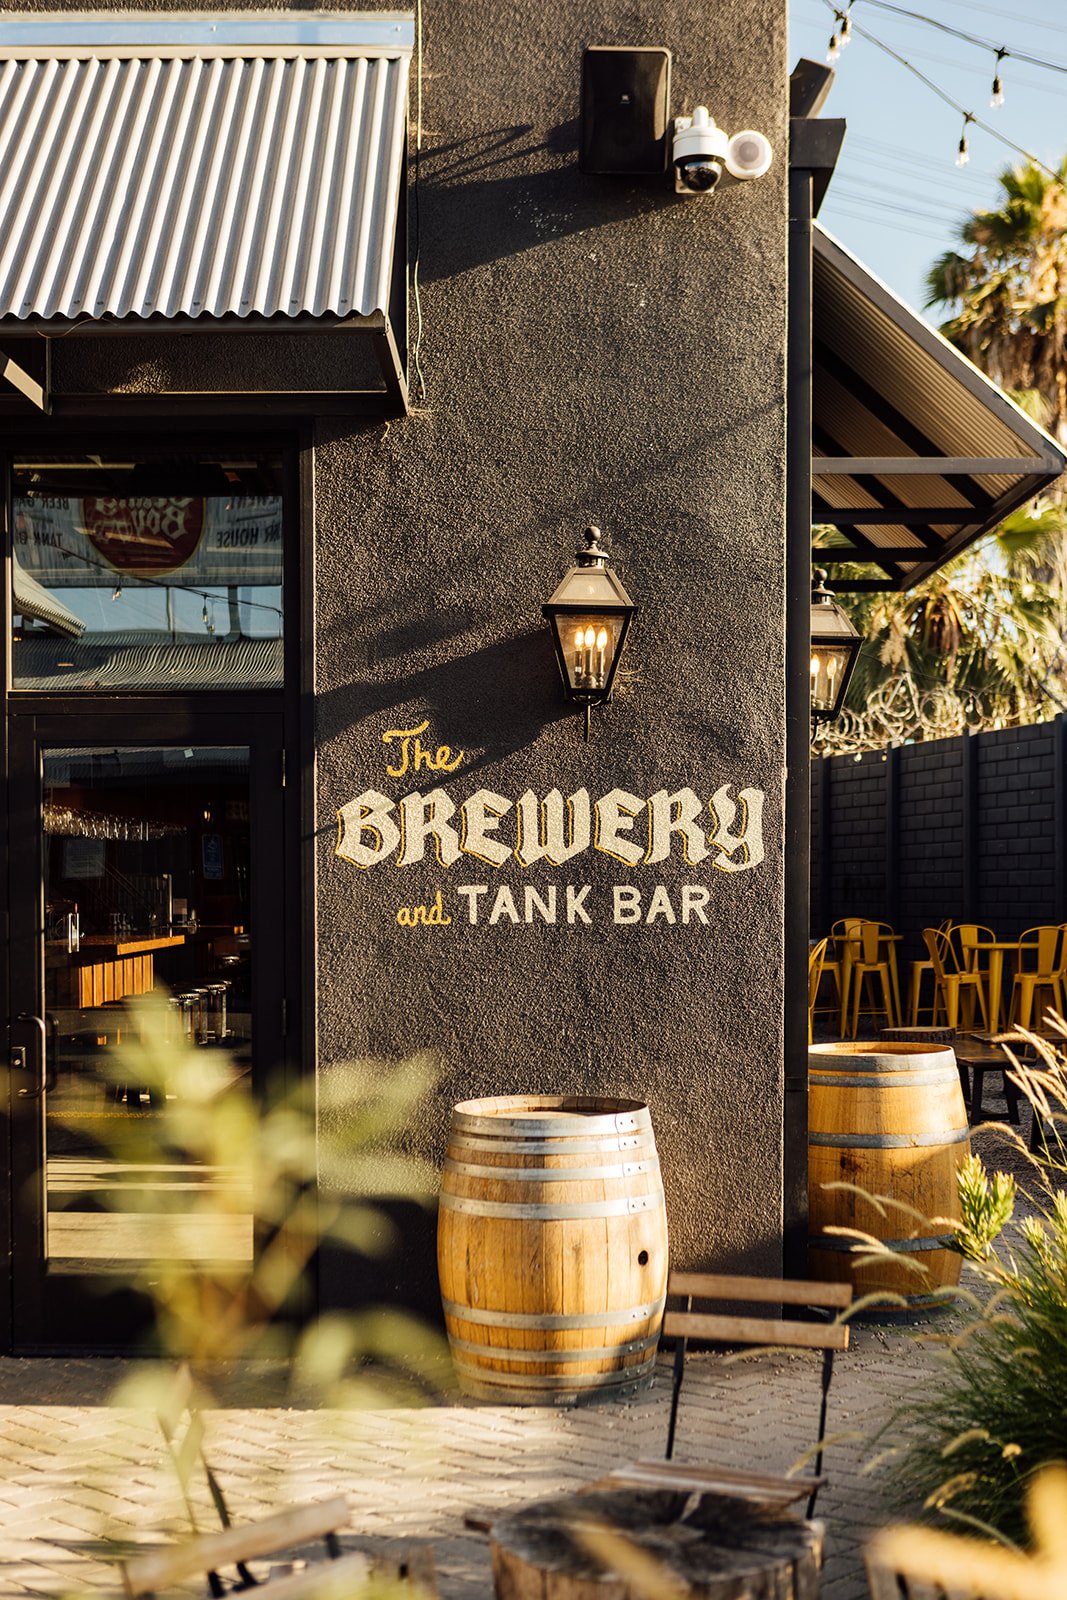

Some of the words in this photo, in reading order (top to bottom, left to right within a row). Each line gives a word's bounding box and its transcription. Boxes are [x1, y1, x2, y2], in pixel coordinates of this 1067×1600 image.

[382, 719, 464, 777] The
[335, 783, 765, 873] BREWERY
[397, 891, 452, 927] and
[457, 885, 592, 925] TANK
[613, 885, 710, 925] BAR
